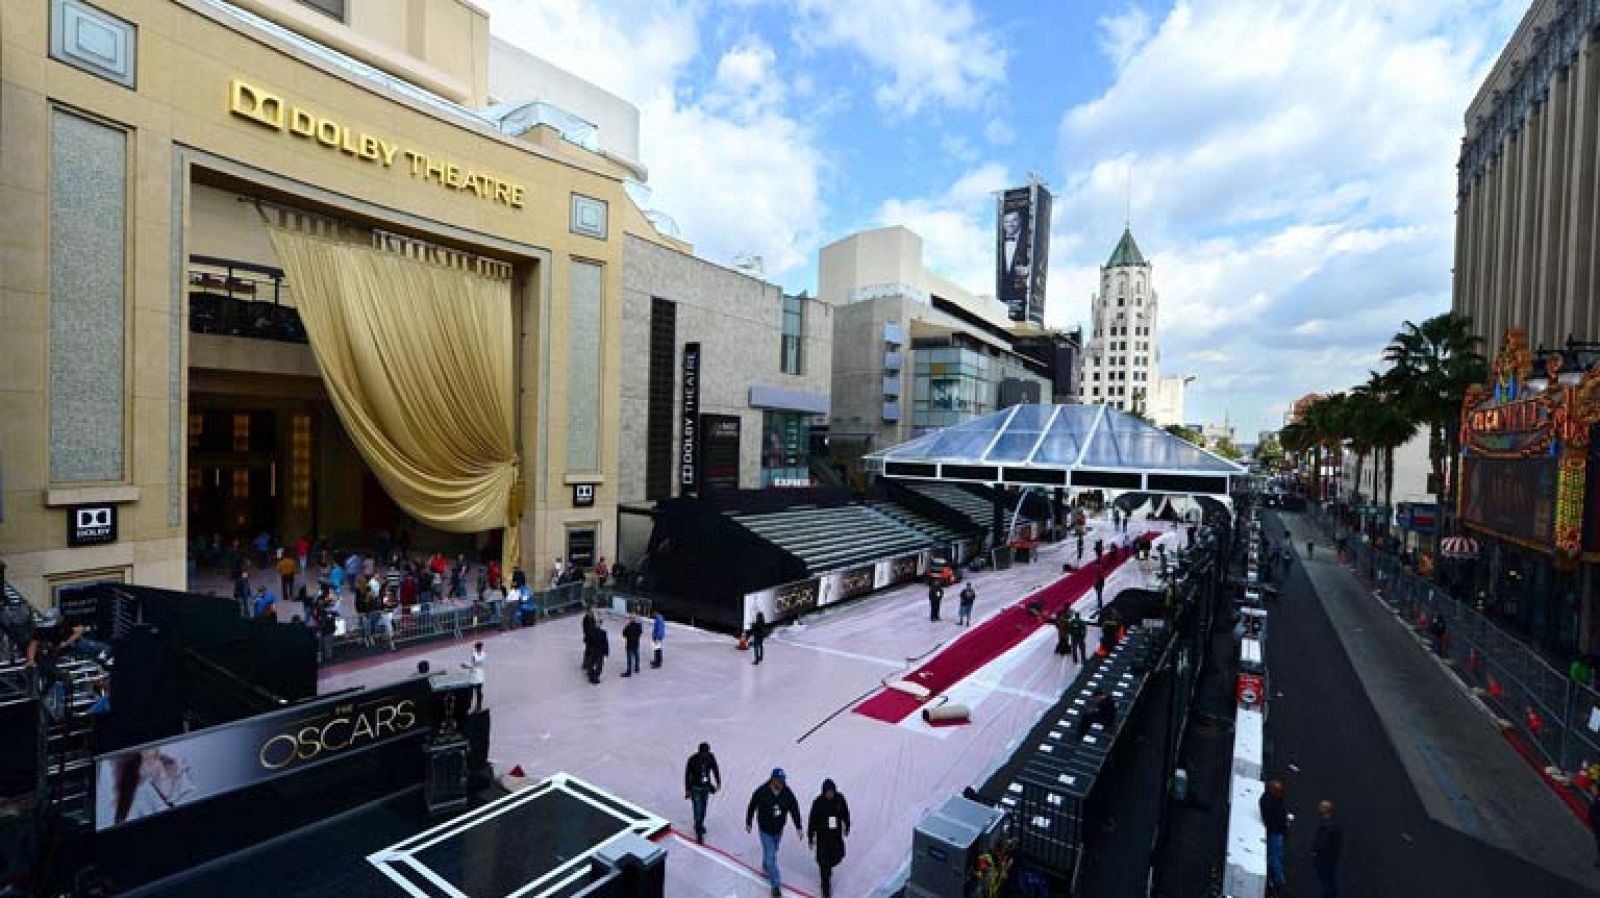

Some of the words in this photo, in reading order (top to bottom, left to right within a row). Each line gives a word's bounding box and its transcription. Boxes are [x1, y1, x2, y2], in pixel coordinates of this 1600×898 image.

[289, 106, 399, 168] DOLBY
[404, 150, 526, 208] THEATRE
[682, 418, 693, 463] DOLBY
[76, 528, 111, 538] DOLBY
[260, 699, 416, 769] OSCARS
